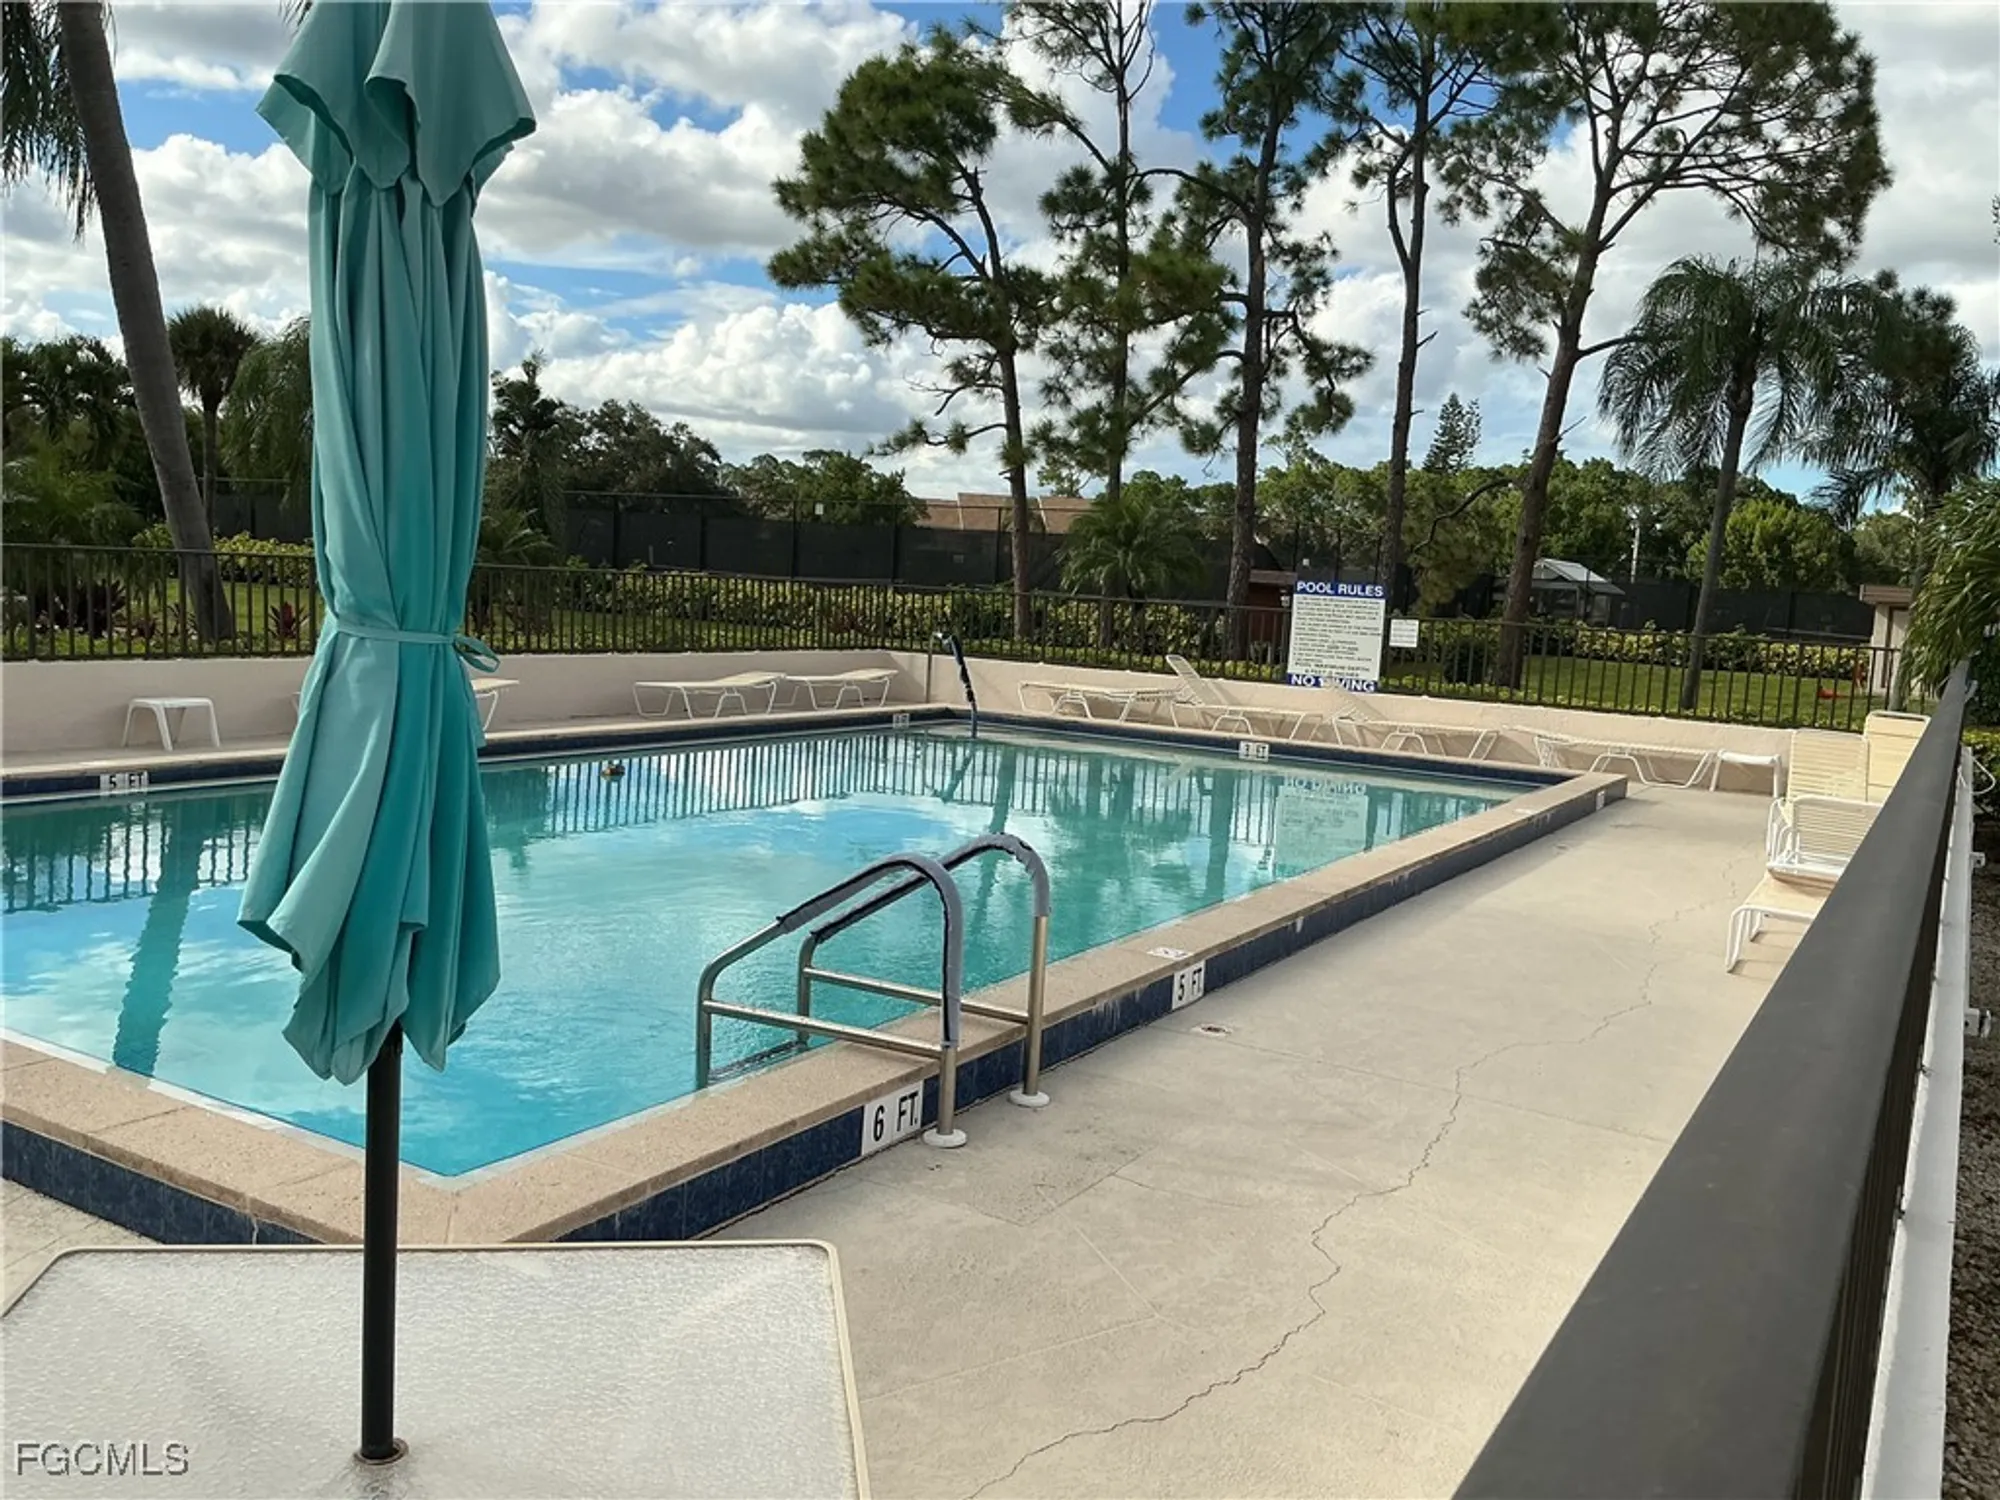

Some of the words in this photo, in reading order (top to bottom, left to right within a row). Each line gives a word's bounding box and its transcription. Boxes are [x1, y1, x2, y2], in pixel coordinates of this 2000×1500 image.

[1297, 581, 1335, 594] POOL
[1338, 584, 1384, 597] RULES
[1291, 674, 1316, 688] NO
[1178, 974, 1186, 1001] 5
[873, 1104, 885, 1142] 6
[897, 1090, 919, 1132] FT.
